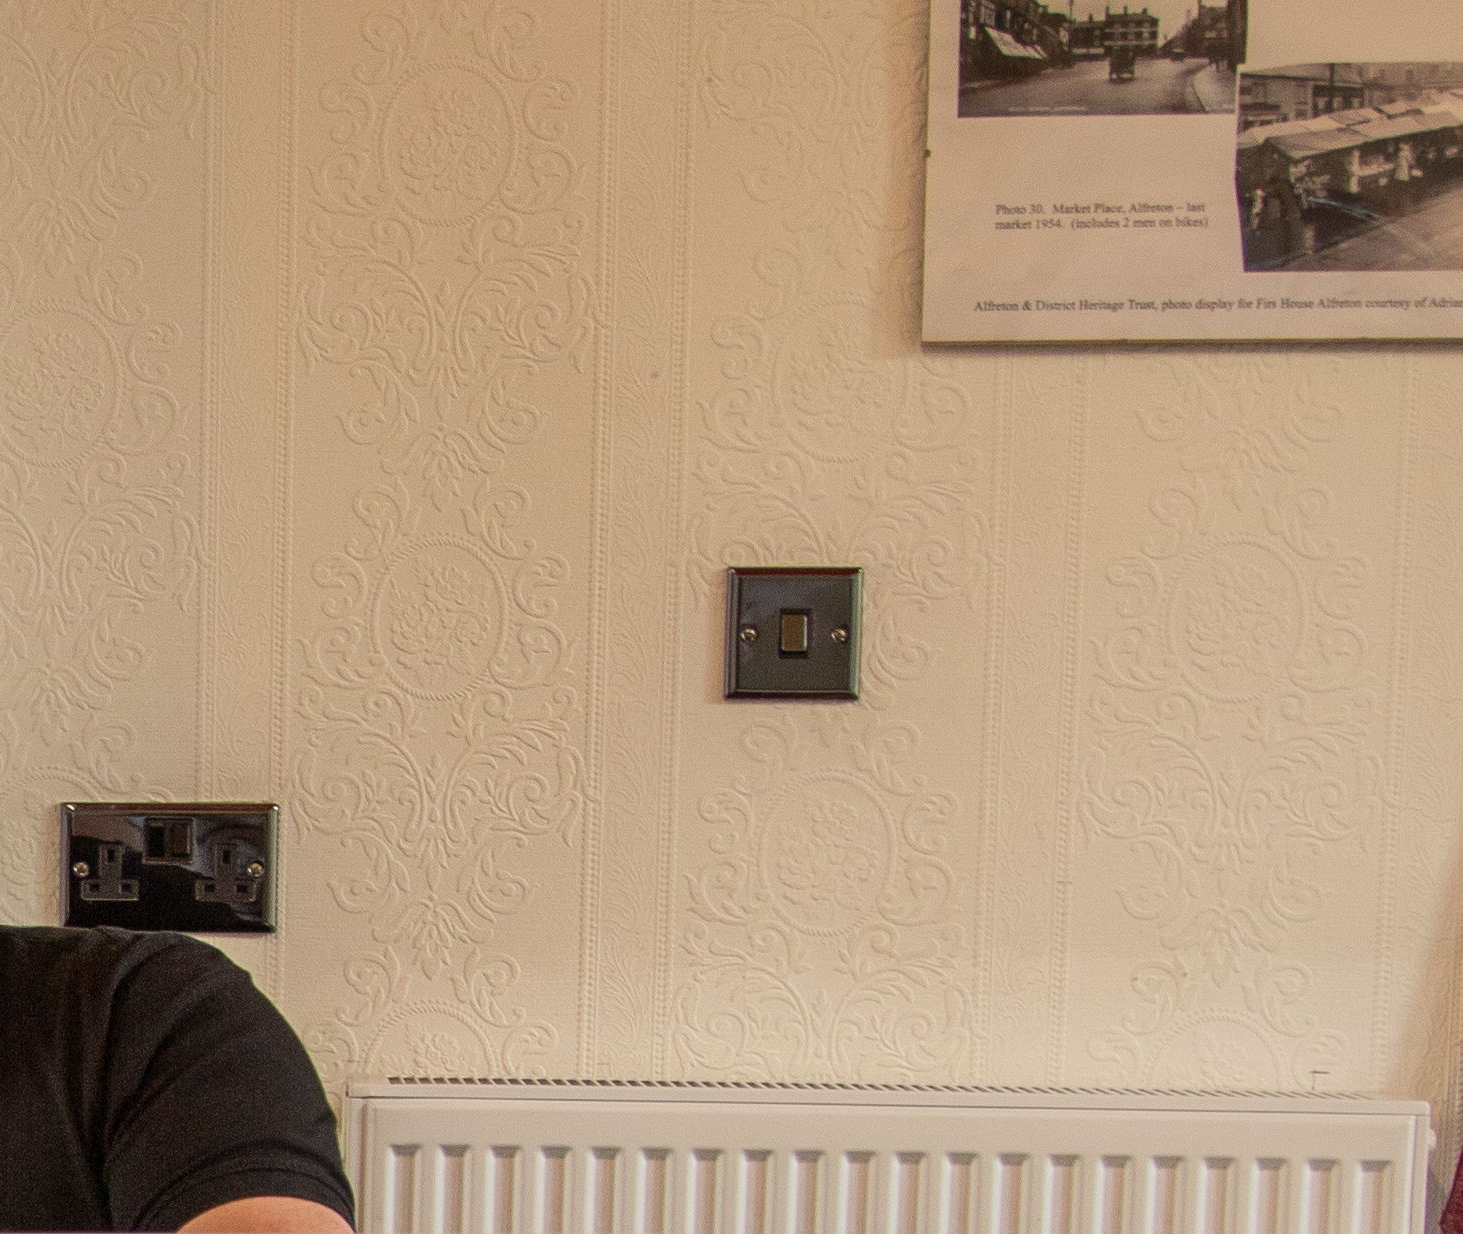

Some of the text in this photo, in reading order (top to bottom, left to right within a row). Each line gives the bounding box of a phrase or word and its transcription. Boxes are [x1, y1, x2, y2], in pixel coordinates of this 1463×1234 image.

[995, 204, 1027, 215] Photo
[1052, 203, 1091, 215] Market
[1129, 202, 1173, 214] Alfreton
[1186, 202, 1206, 213] last
[995, 219, 1032, 230] market
[1071, 217, 1120, 230] (includes
[1133, 219, 1156, 228] men
[1158, 219, 1173, 228] on
[1175, 217, 1209, 229] bikes)
[973, 300, 1018, 312] Alfreton
[1022, 301, 1032, 311] &
[1036, 300, 1076, 311] District
[1078, 299, 1124, 313] Heritage
[1161, 299, 1193, 312] photo
[1195, 298, 1234, 312] display
[1237, 298, 1253, 309] for
[1280, 298, 1314, 309] House
[1318, 298, 1363, 309] Alfreton
[1365, 298, 1410, 311] courtesy
[1414, 297, 1426, 308] of
